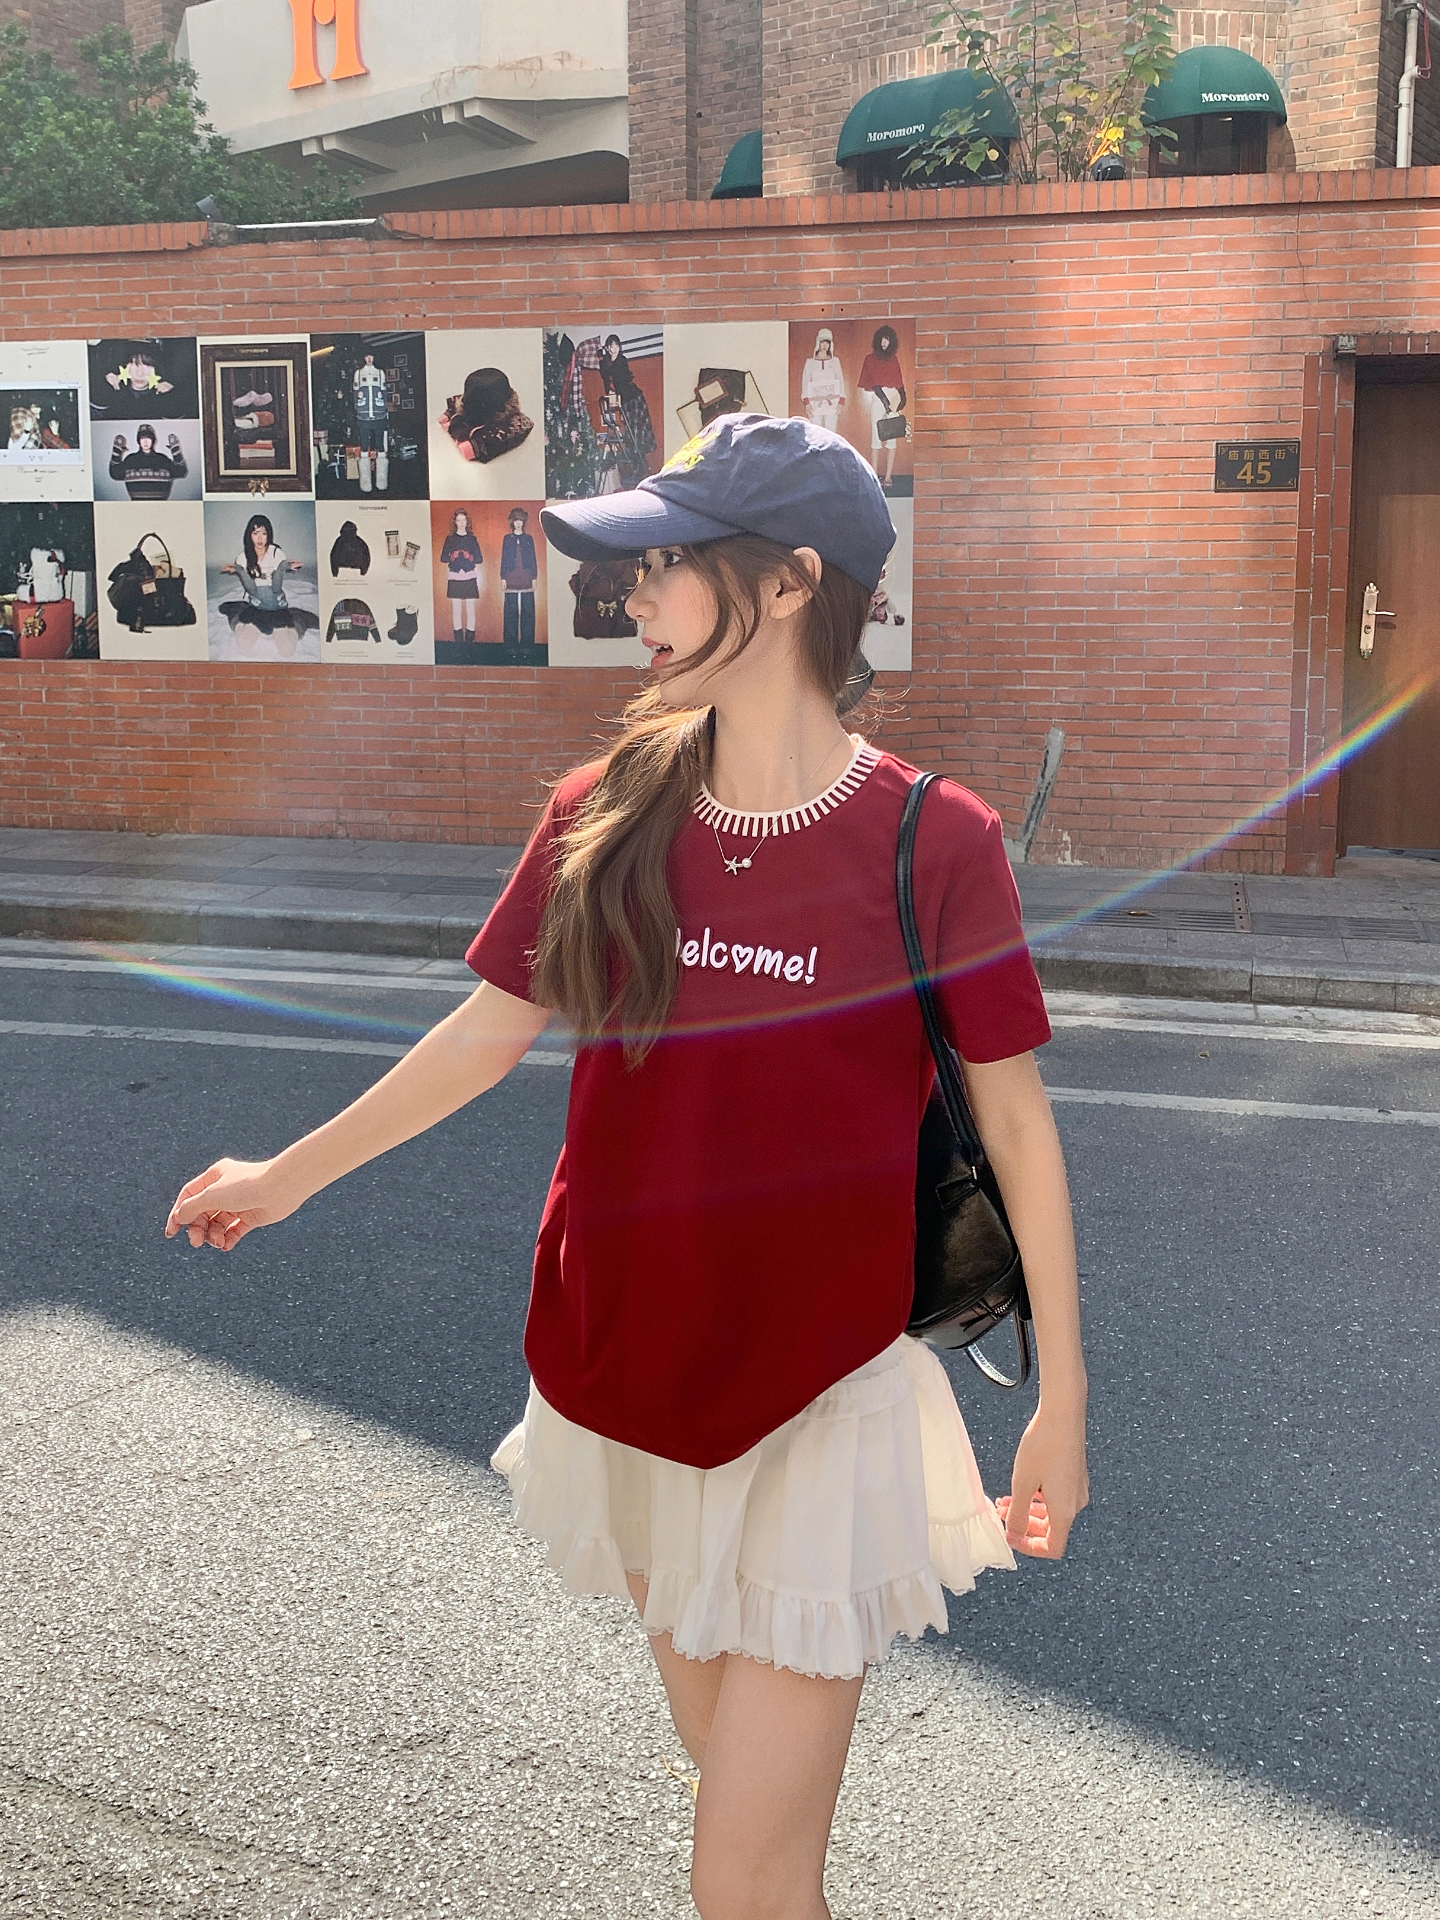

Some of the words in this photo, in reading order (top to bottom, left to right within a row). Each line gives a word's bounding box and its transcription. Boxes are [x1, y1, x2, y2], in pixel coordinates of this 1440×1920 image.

[1201, 92, 1270, 103] Moromoro
[866, 123, 925, 142] Moromoro
[1236, 461, 1271, 485] 45
[675, 927, 818, 985] elcome!
